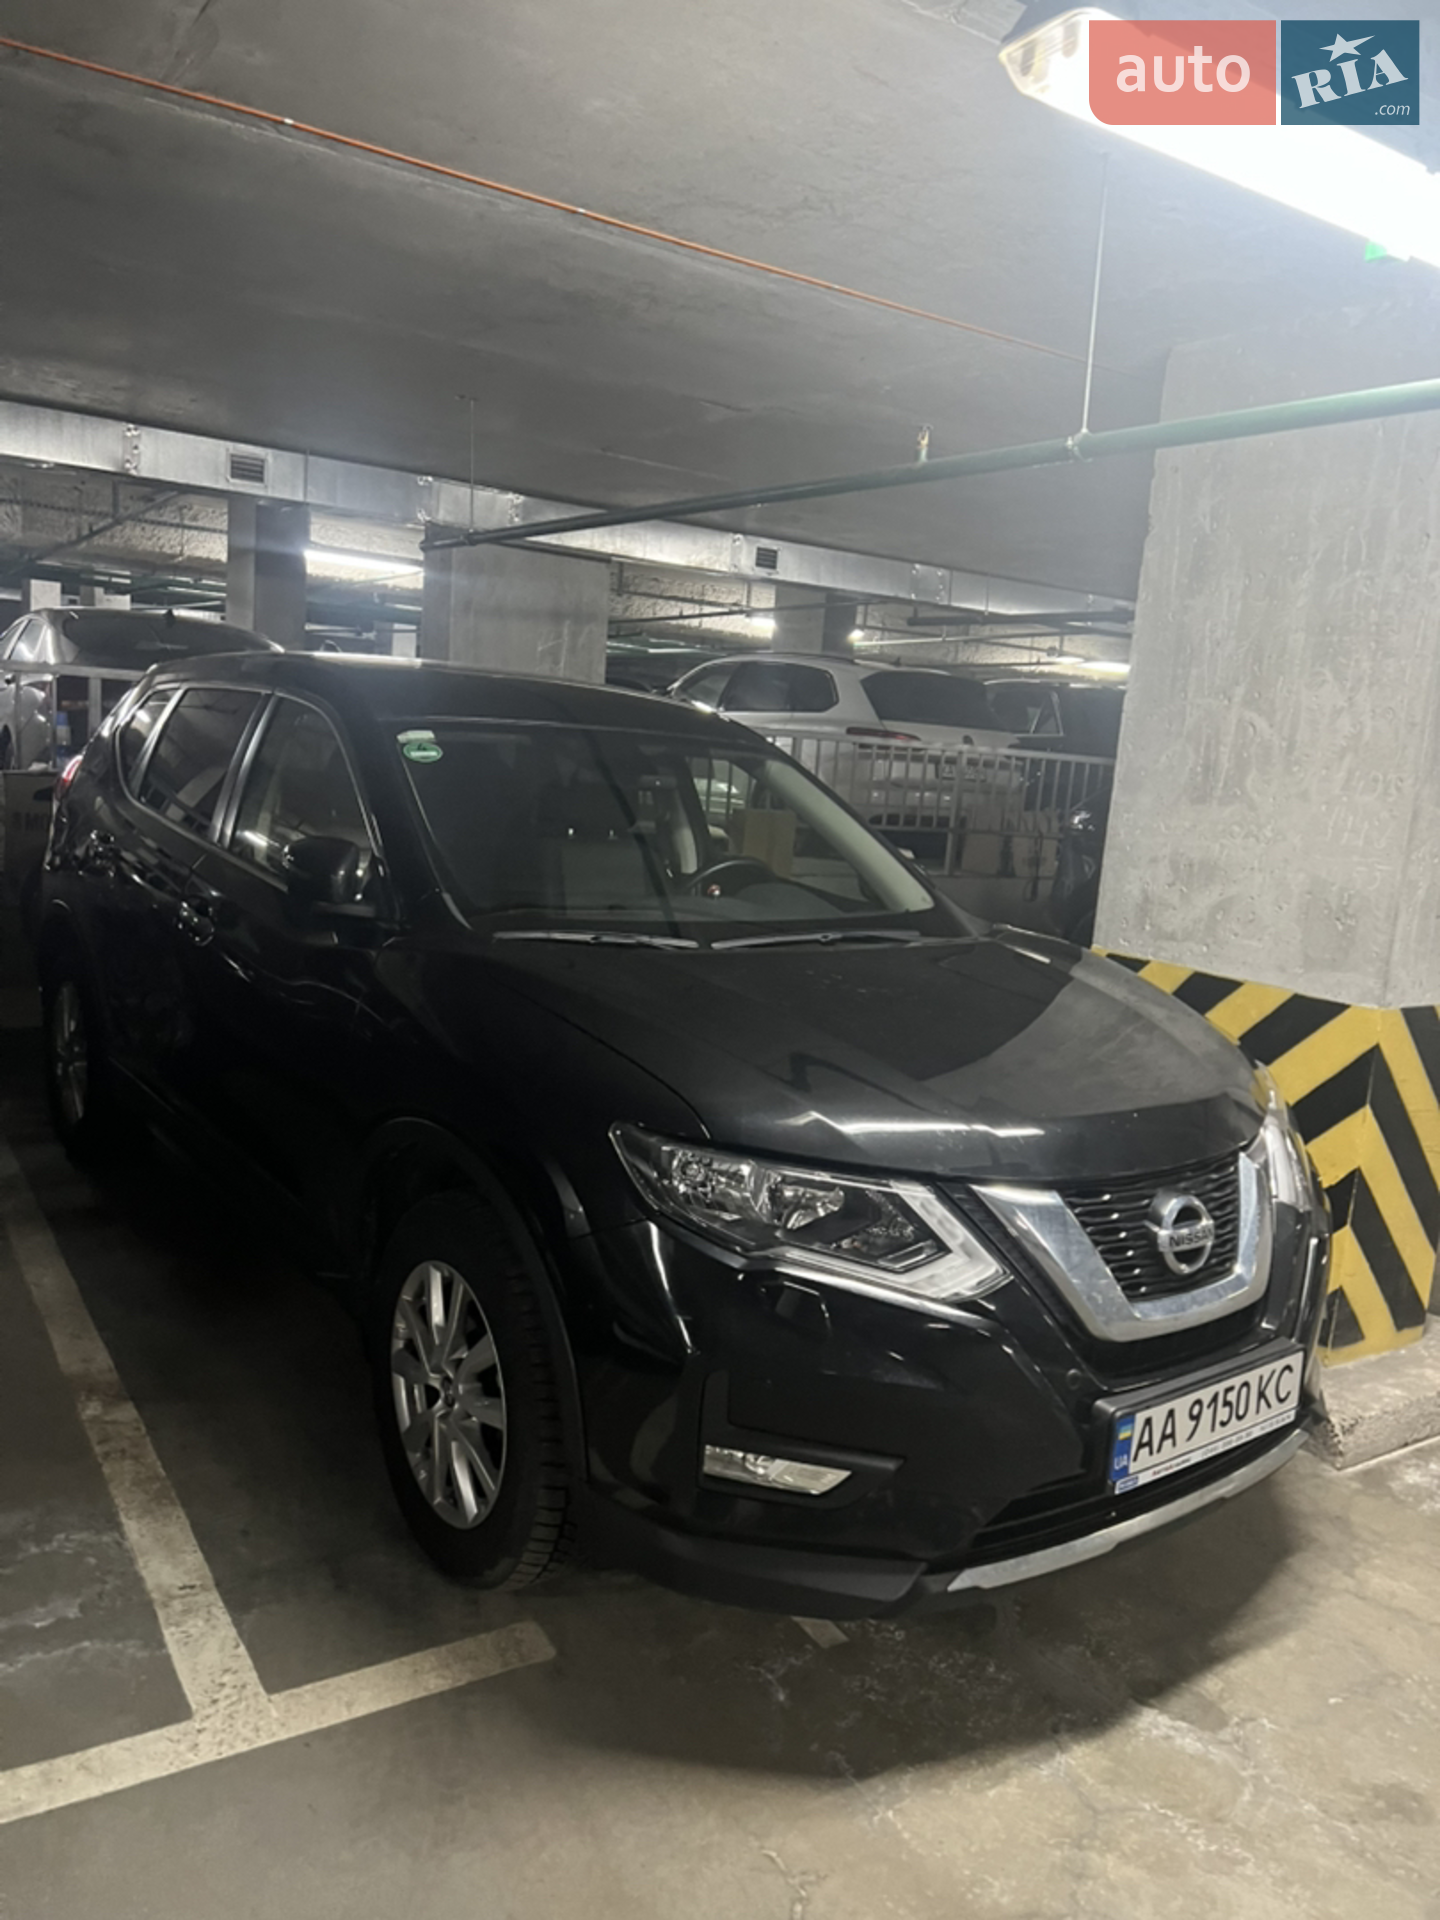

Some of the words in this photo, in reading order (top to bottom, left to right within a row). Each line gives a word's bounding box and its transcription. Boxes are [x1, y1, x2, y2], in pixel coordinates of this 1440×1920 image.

[1169, 1229, 1214, 1247] NISSAN
[1133, 1409, 1177, 1462] AA
[1186, 1380, 1251, 1442] 9150
[1256, 1364, 1294, 1415] KC
[1114, 1455, 1128, 1470] UA
